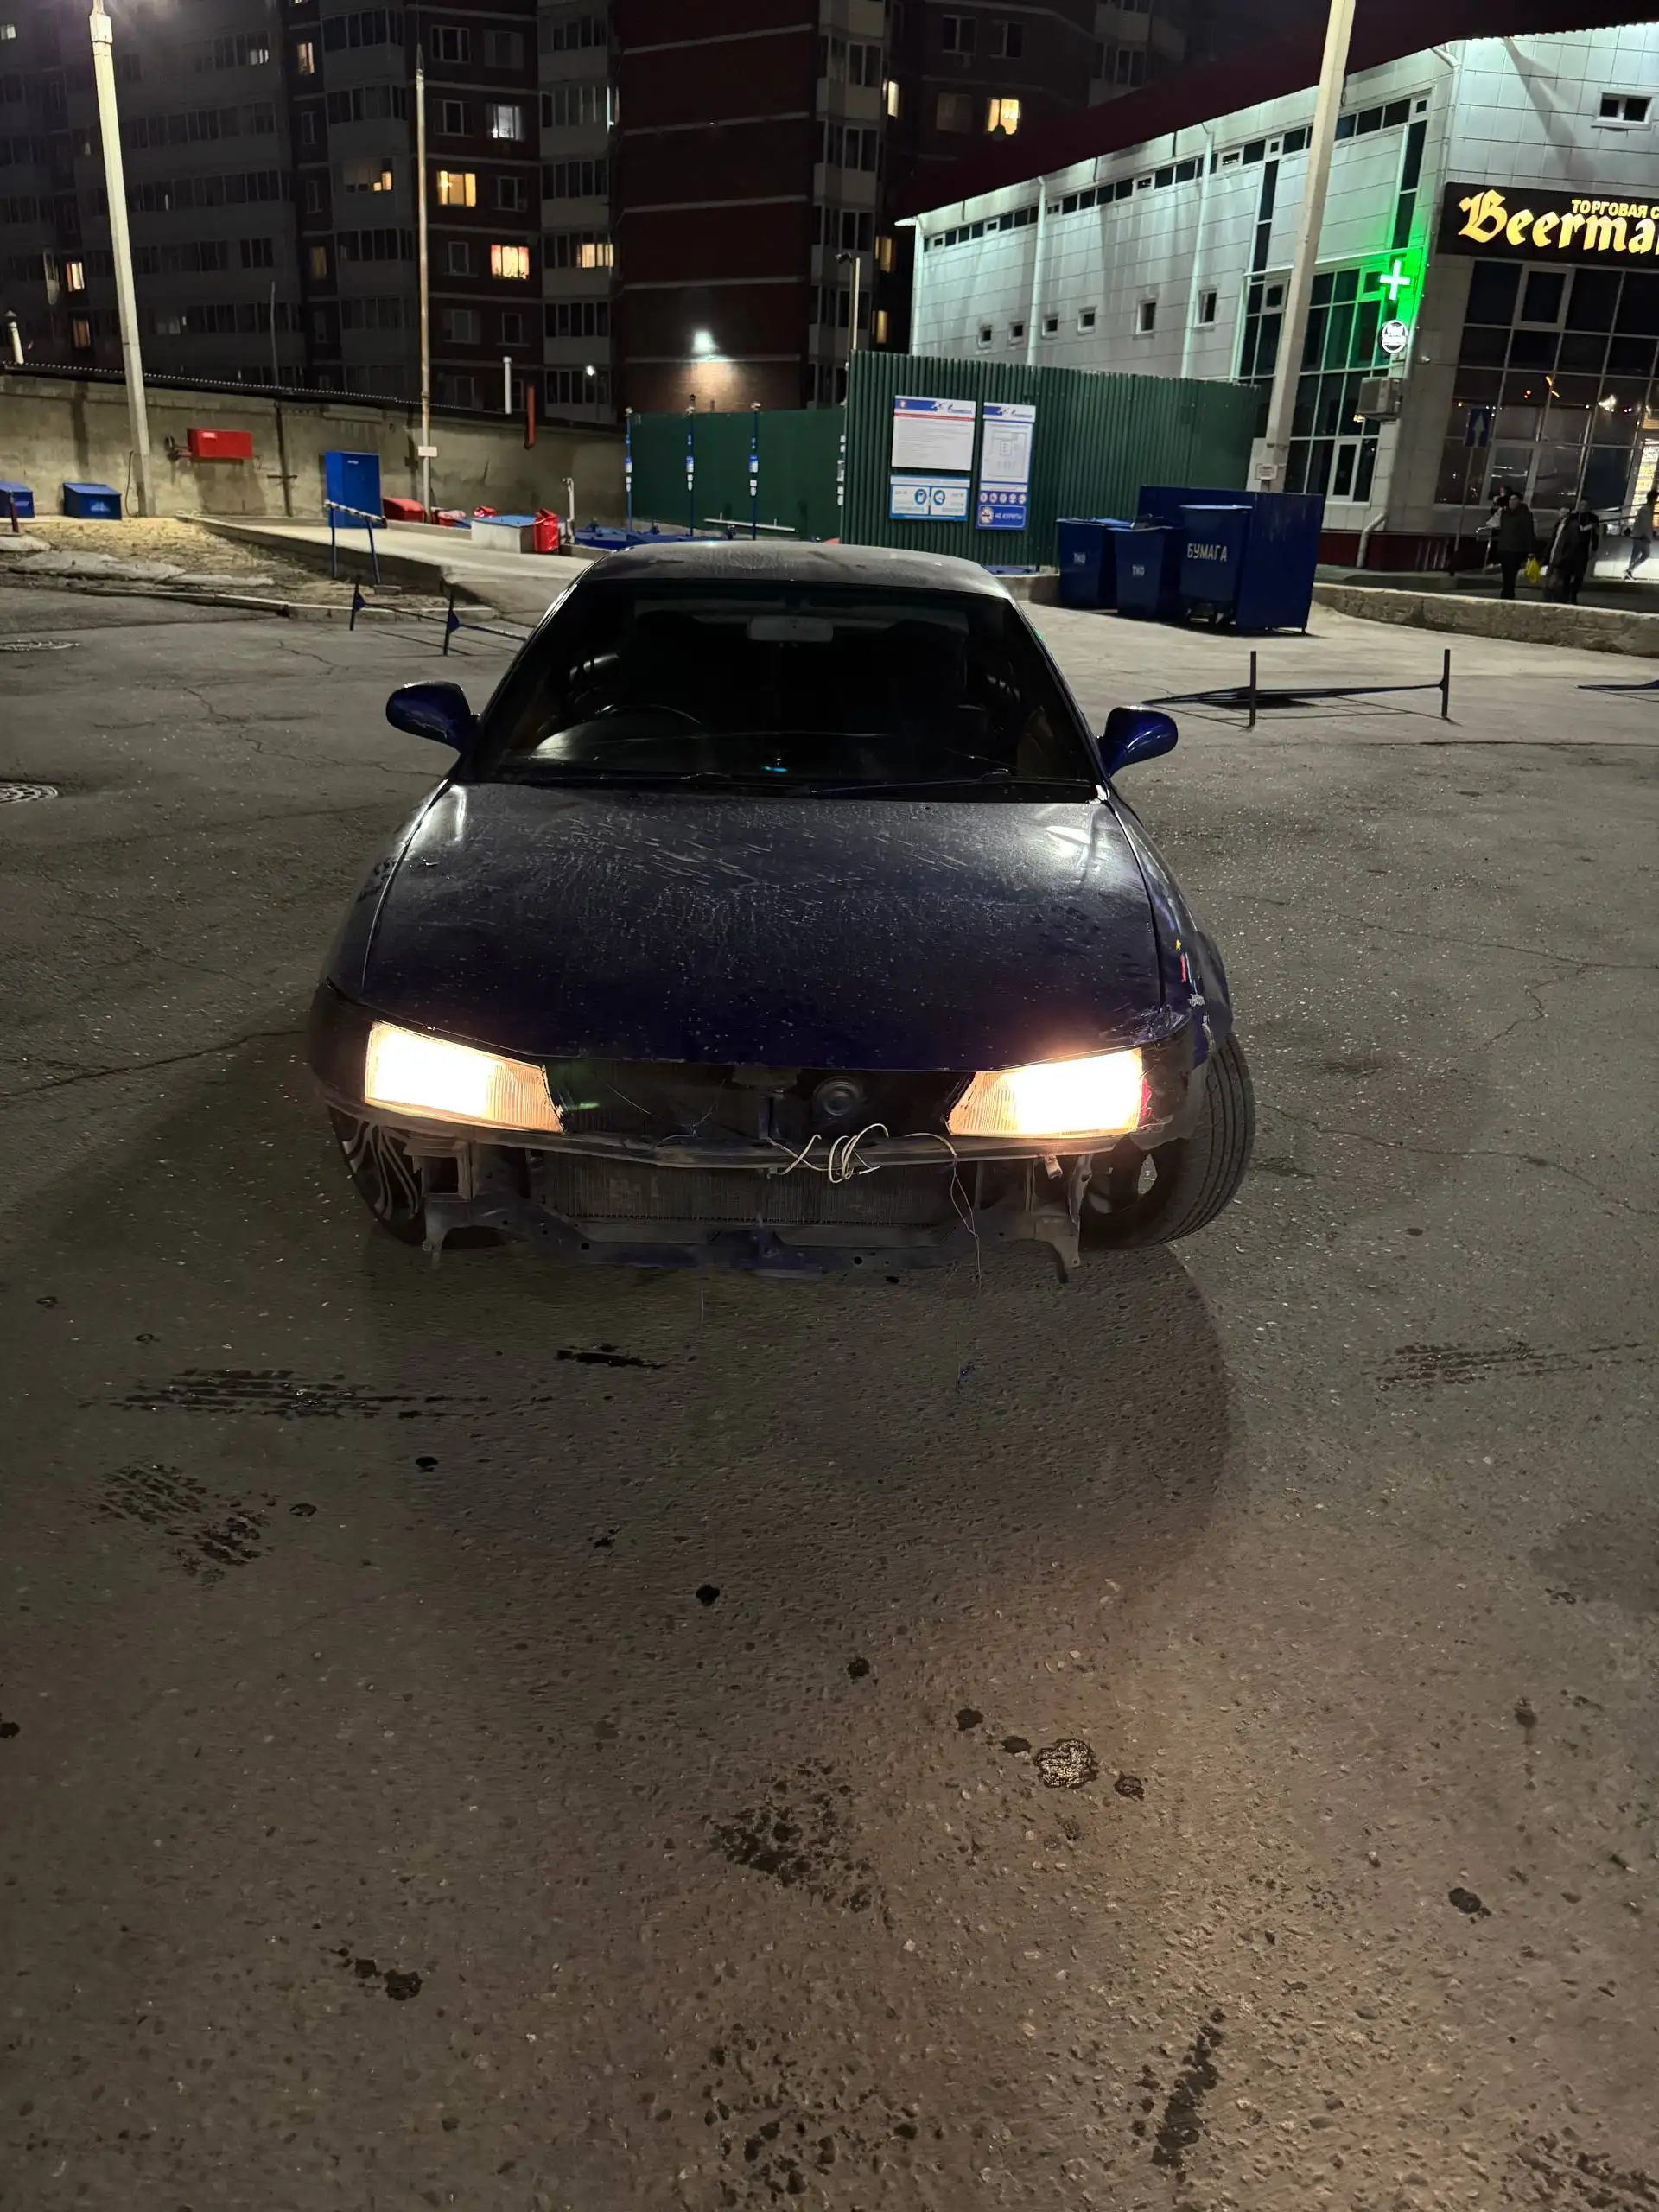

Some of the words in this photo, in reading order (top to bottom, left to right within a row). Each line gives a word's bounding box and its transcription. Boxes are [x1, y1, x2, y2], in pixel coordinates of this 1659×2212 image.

[1572, 200, 1649, 219] ТОРГОВАЯ
[1458, 188, 1659, 256] Beerma
[1187, 543, 1228, 562] БУМАГА
